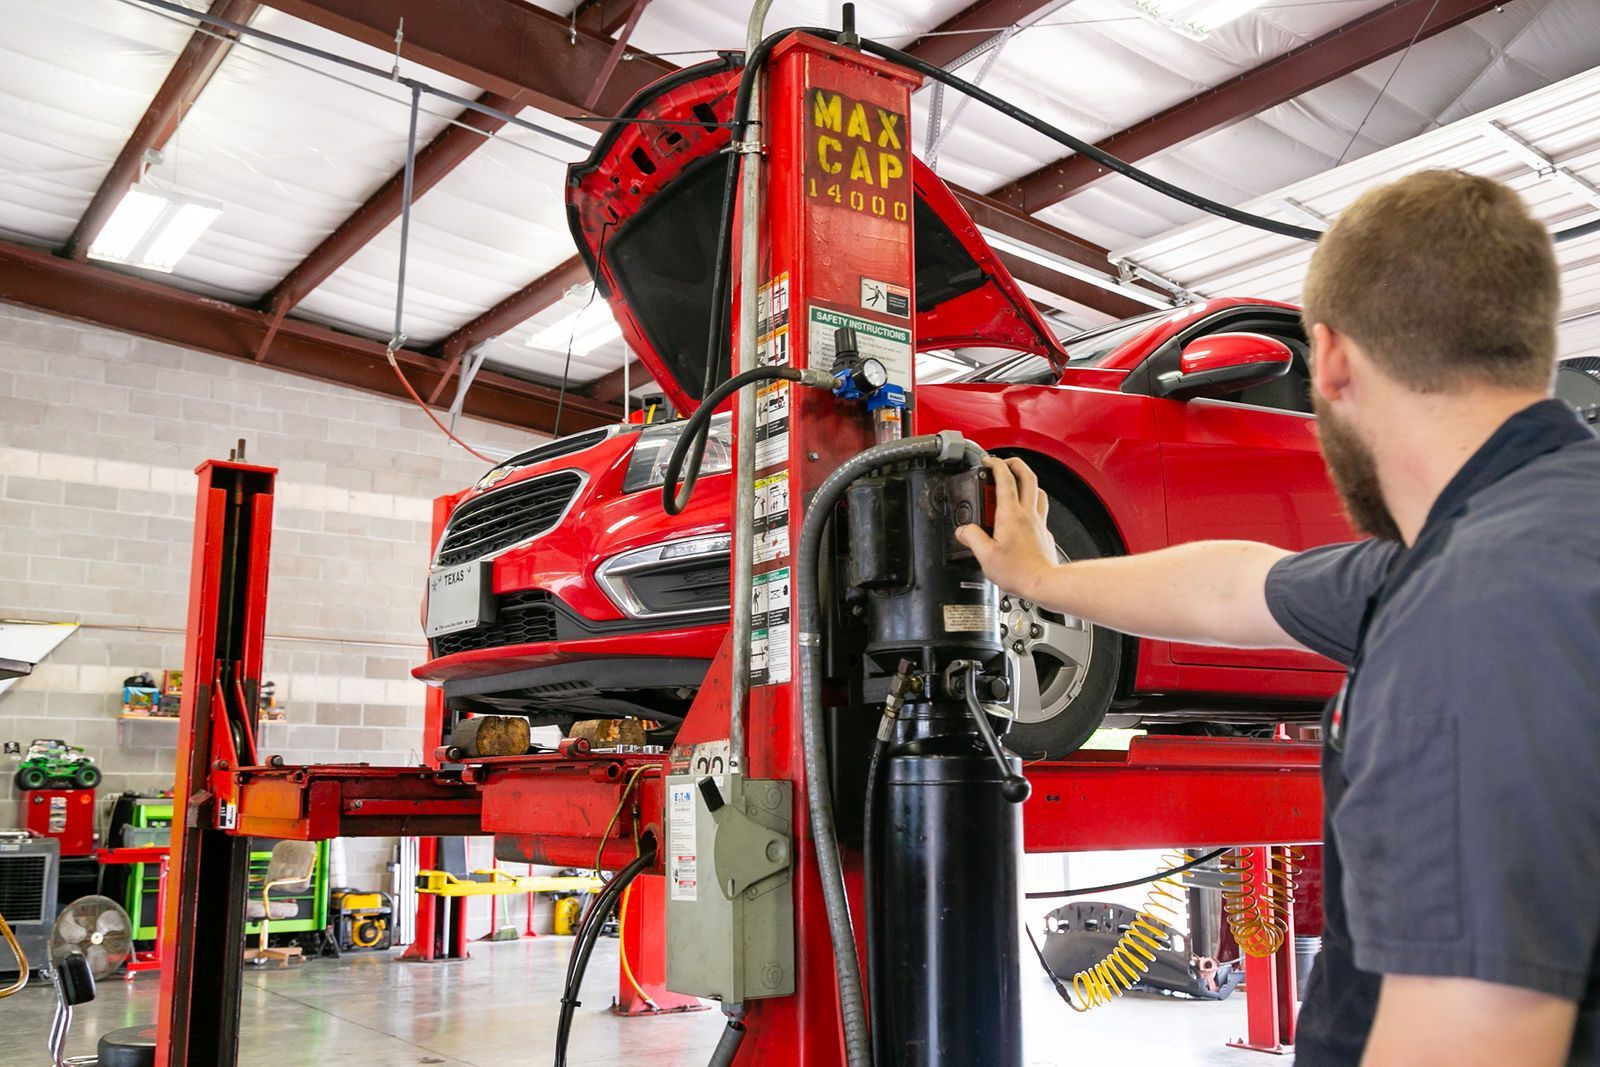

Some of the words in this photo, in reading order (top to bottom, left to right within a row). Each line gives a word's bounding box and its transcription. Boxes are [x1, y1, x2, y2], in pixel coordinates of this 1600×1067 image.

[814, 90, 901, 149] MAX
[818, 135, 903, 189] CAP
[810, 178, 907, 221] 14000
[816, 311, 849, 326] SAFETY
[849, 319, 906, 341] INSTRUCTIONS
[444, 570, 465, 586] TEXAS
